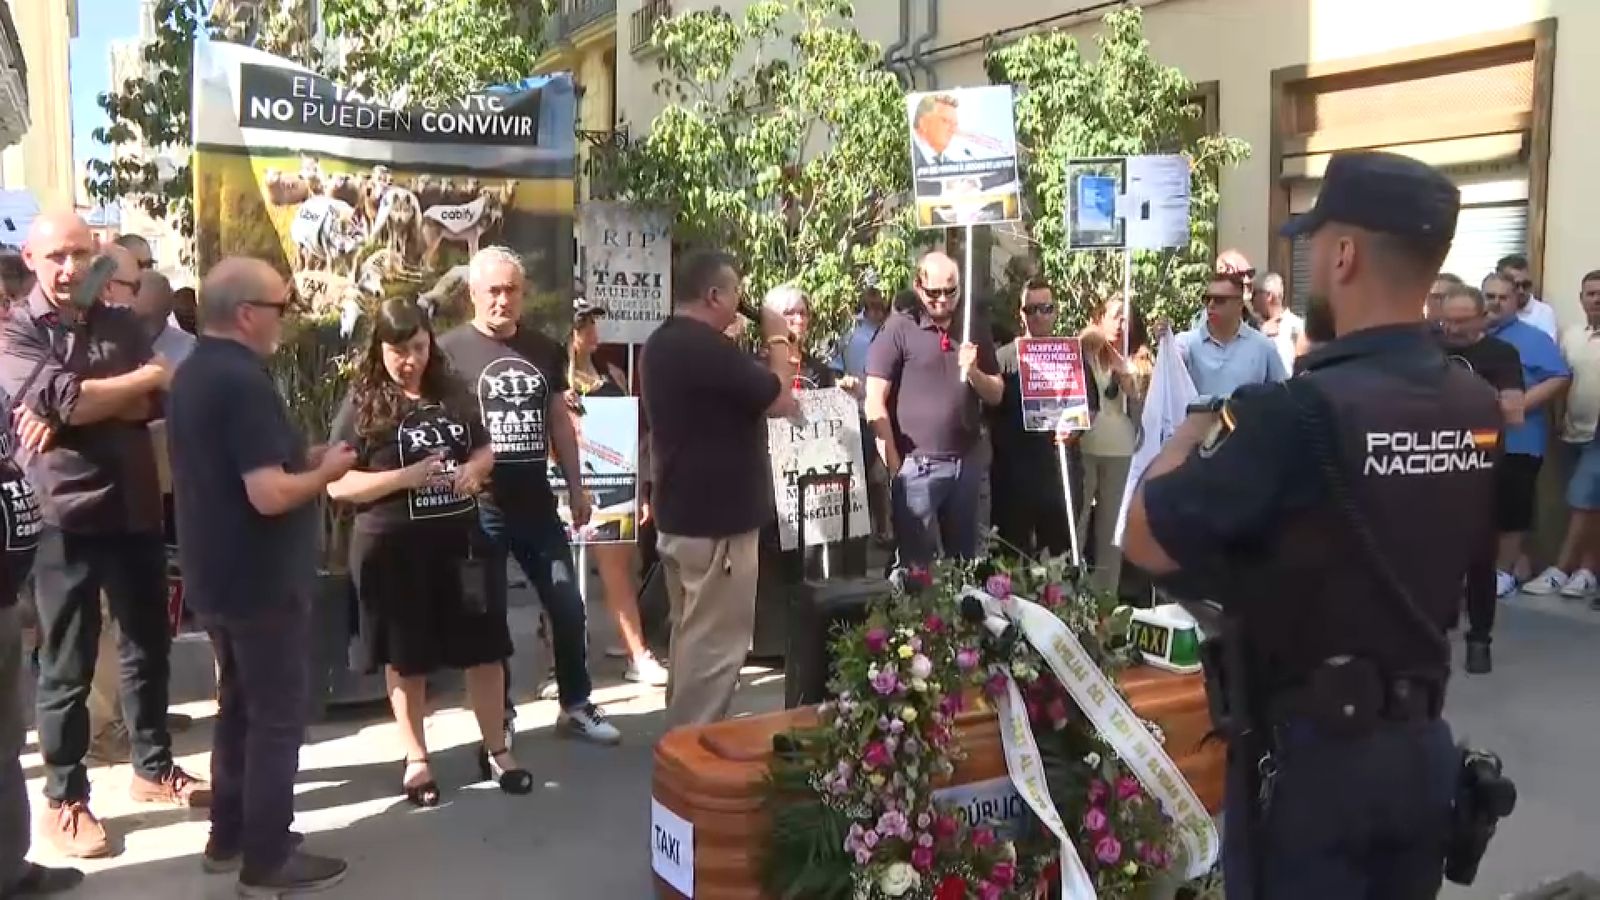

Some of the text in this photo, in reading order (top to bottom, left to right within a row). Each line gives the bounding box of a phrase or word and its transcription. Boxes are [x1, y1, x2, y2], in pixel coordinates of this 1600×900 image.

[292, 76, 322, 99] EL
[251, 97, 294, 121] NO
[302, 102, 411, 132] PUEDEN
[421, 112, 533, 136] CONVIVIR
[441, 209, 475, 221] cabify
[592, 270, 662, 288] TAXI
[594, 286, 661, 299] MUERTO
[601, 309, 662, 320] NSELLERIA
[487, 377, 541, 399] RIP
[487, 410, 542, 423] TAXI
[407, 424, 464, 448] RIP
[790, 419, 843, 443] RIP
[1366, 430, 1475, 453] POLICIA
[1363, 451, 1494, 476] NACIONAL
[1131, 623, 1167, 656] TAXI
[655, 824, 680, 865] TAXI
